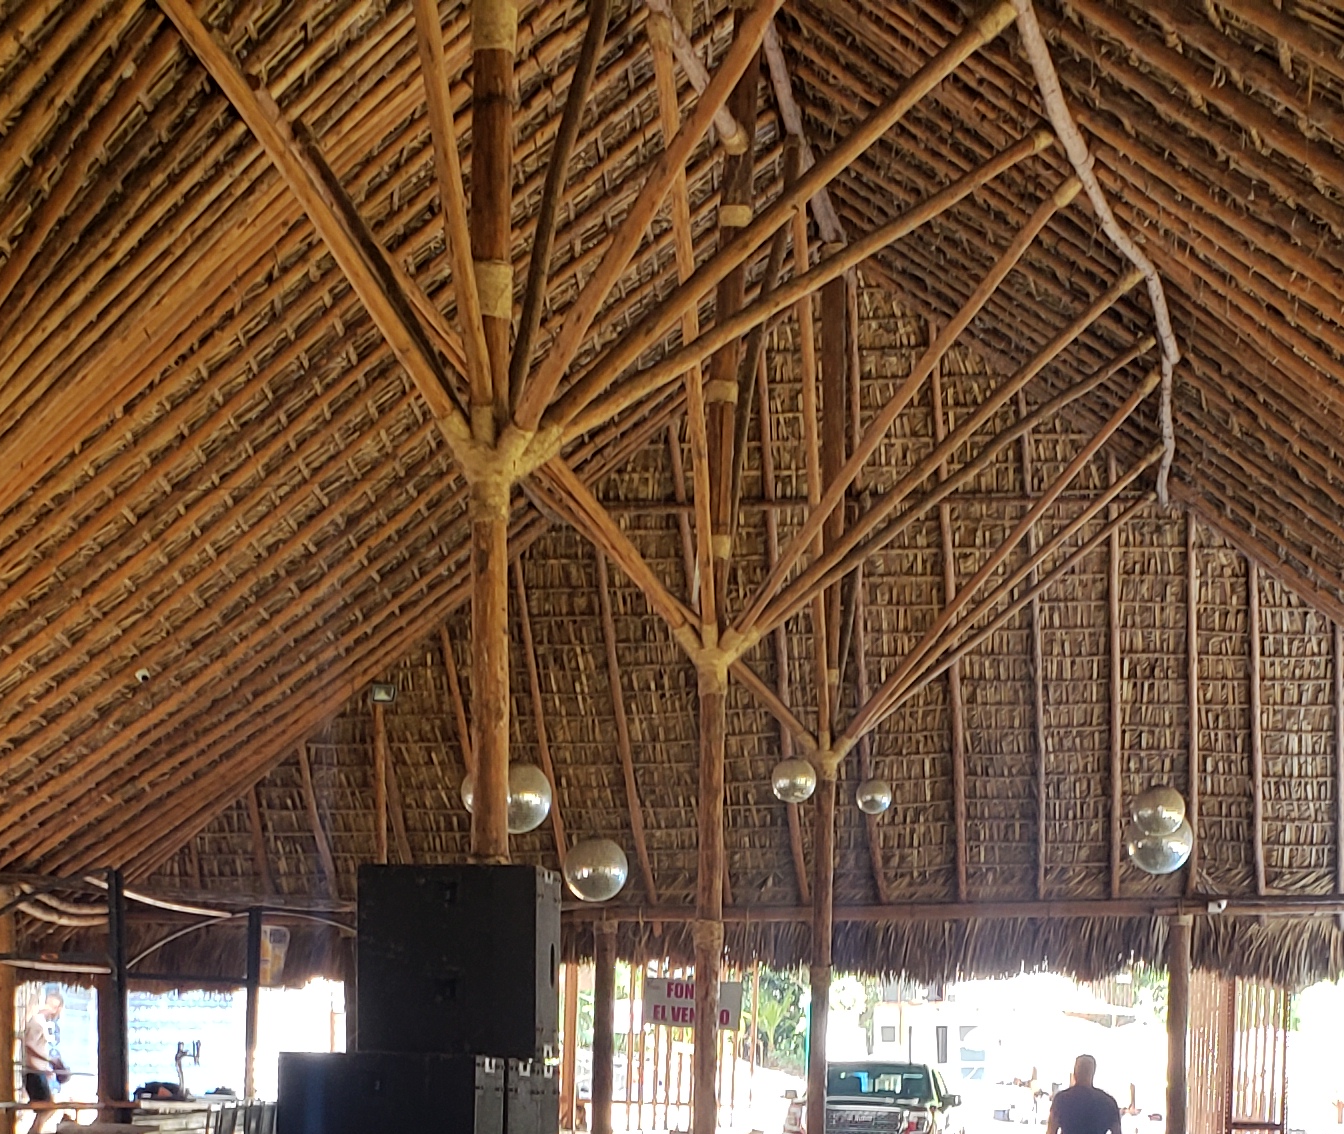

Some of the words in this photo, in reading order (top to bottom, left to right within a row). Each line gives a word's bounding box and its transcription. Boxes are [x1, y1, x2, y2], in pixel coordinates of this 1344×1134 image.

[666, 981, 695, 1000] FON
[653, 1004, 668, 1021] EL
[671, 1006, 730, 1026] VENO
